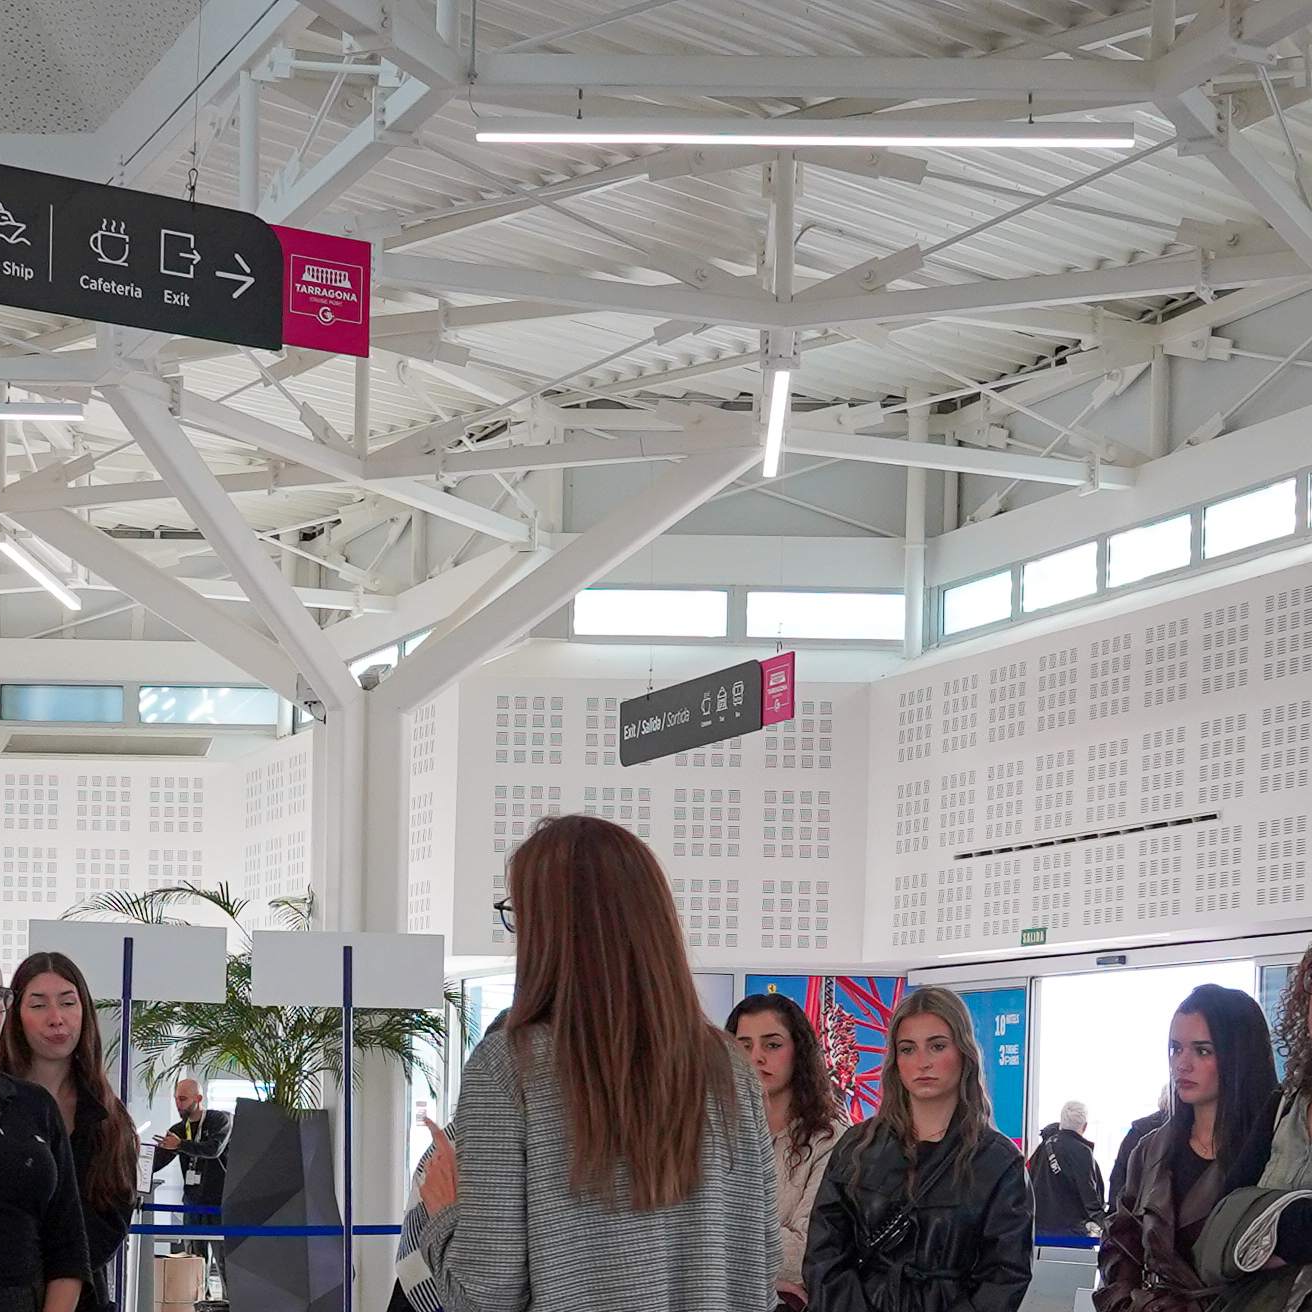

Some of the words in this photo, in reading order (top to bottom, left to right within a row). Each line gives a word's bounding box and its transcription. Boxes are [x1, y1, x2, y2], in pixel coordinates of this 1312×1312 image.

[3, 261, 34, 281] Ship
[79, 275, 143, 298] Cafeteria
[295, 283, 358, 303] TARRAGONA
[163, 289, 190, 307] Exit
[999, 1044, 1006, 1066] 3
